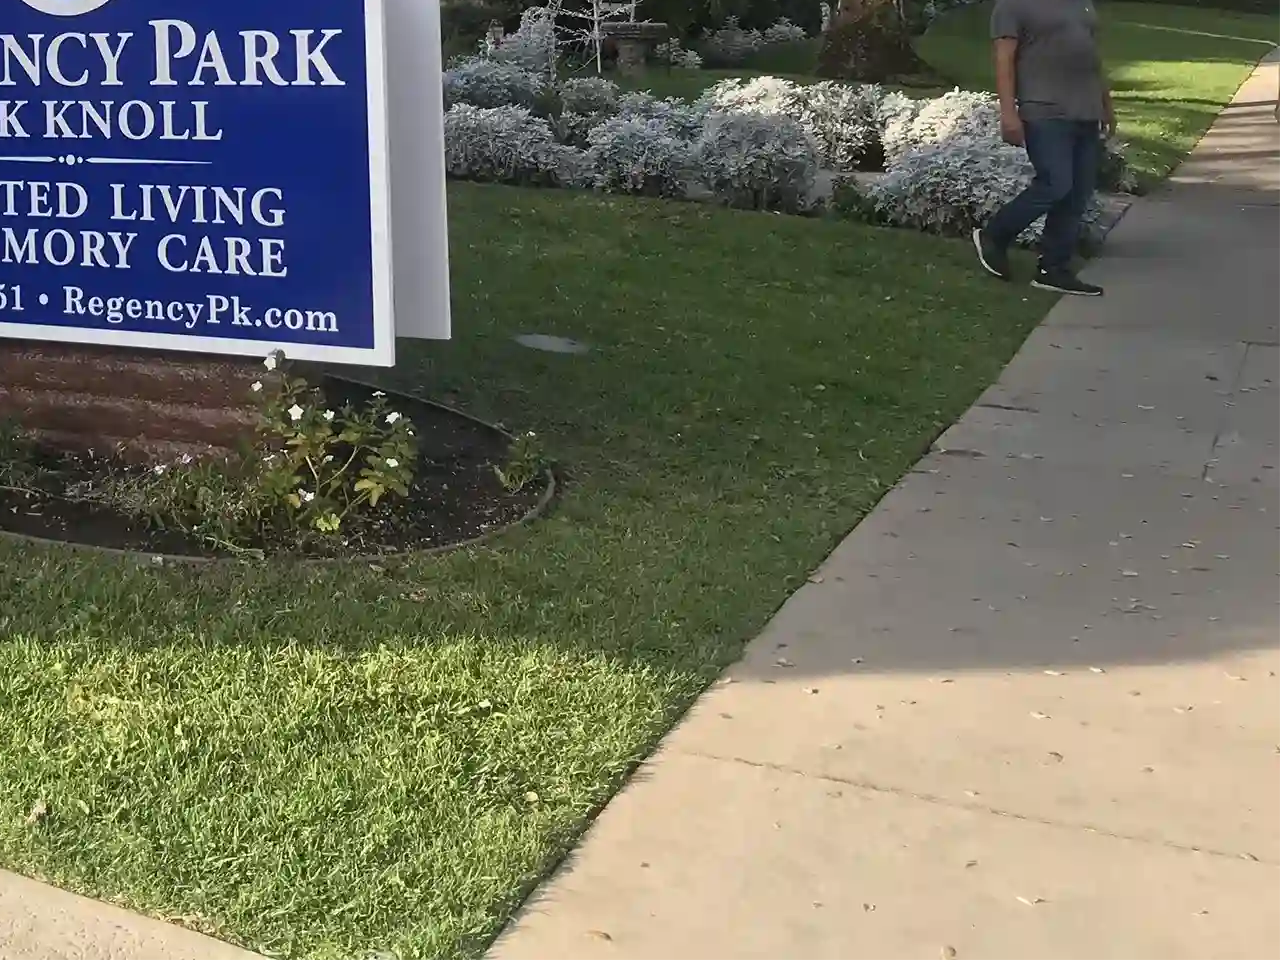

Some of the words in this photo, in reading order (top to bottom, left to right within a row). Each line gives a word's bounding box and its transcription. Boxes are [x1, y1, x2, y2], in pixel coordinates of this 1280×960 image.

[149, 19, 346, 86] PARK
[42, 100, 223, 141] KNOLL
[109, 183, 286, 227] LIVING
[157, 233, 288, 278] CARE
[62, 286, 340, 333] RegencyPk.com
